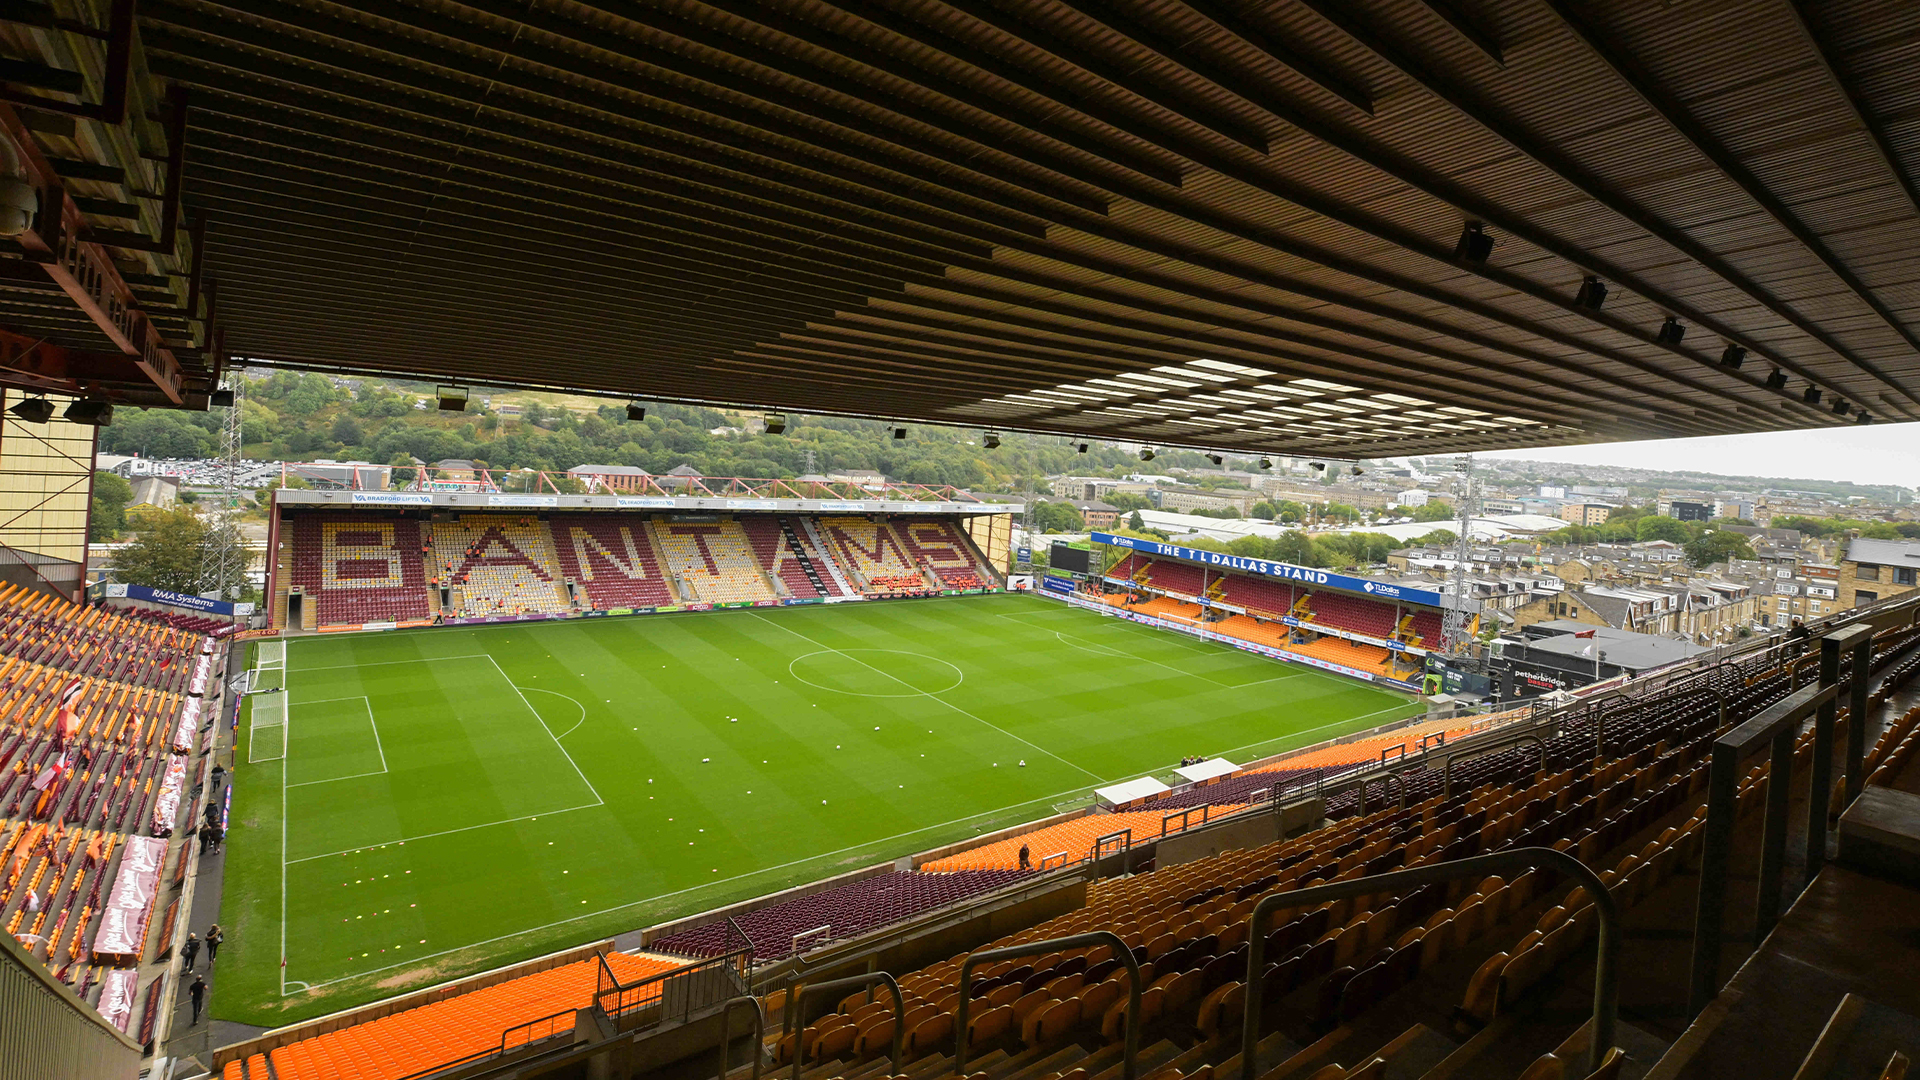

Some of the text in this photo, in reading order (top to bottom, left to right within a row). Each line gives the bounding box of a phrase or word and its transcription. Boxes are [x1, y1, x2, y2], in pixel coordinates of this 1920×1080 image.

[1157, 544, 1328, 584] THE T L DALLAS STAND
[152, 589, 215, 608] RMA Systems
[1514, 670, 1566, 687] petherbridge
[1527, 677, 1554, 689] bassra
